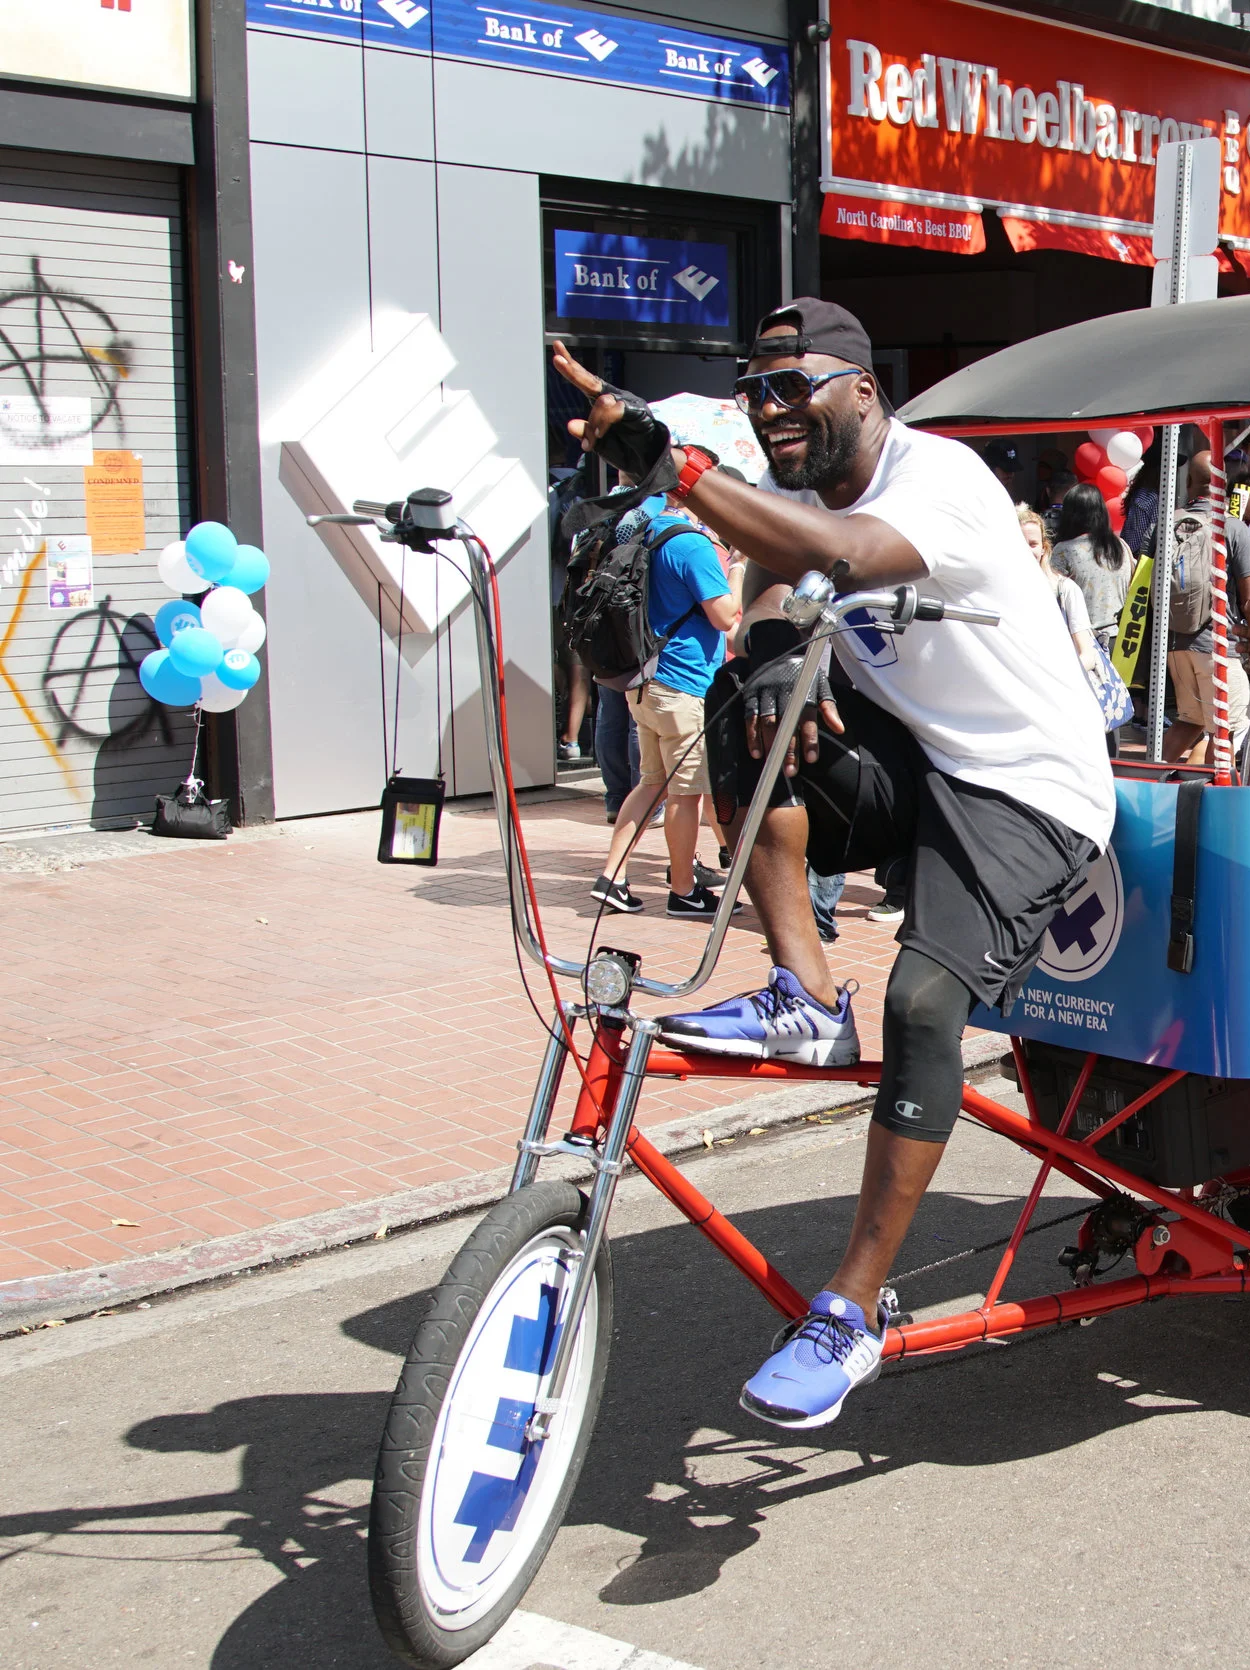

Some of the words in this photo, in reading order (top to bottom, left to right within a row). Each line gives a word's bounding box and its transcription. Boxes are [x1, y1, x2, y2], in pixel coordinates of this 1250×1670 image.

[485, 17, 538, 44] Bank
[542, 29, 563, 49] of
[665, 49, 710, 73] Bank
[714, 58, 733, 76] of
[1223, 109, 1241, 195] BBQ
[836, 207, 868, 227] North
[870, 211, 923, 235] Carolina's
[925, 219, 947, 237] Best
[949, 223, 972, 242] BBQ!
[574, 264, 630, 290] Bank
[637, 268, 660, 291] of
[8, 414, 38, 423] NOTICE
[52, 415, 82, 425] VACATE
[88, 477, 139, 485] CONDEMNED
[0, 476, 51, 589] mile!
[1018, 987, 1025, 1000] A
[1027, 987, 1053, 1005] NEW
[1055, 993, 1115, 1016] CURRENCY
[1024, 1003, 1045, 1020] FOR
[1047, 1008, 1056, 1022] A
[1058, 1009, 1084, 1027] NEW
[1086, 1015, 1108, 1032] ERA
